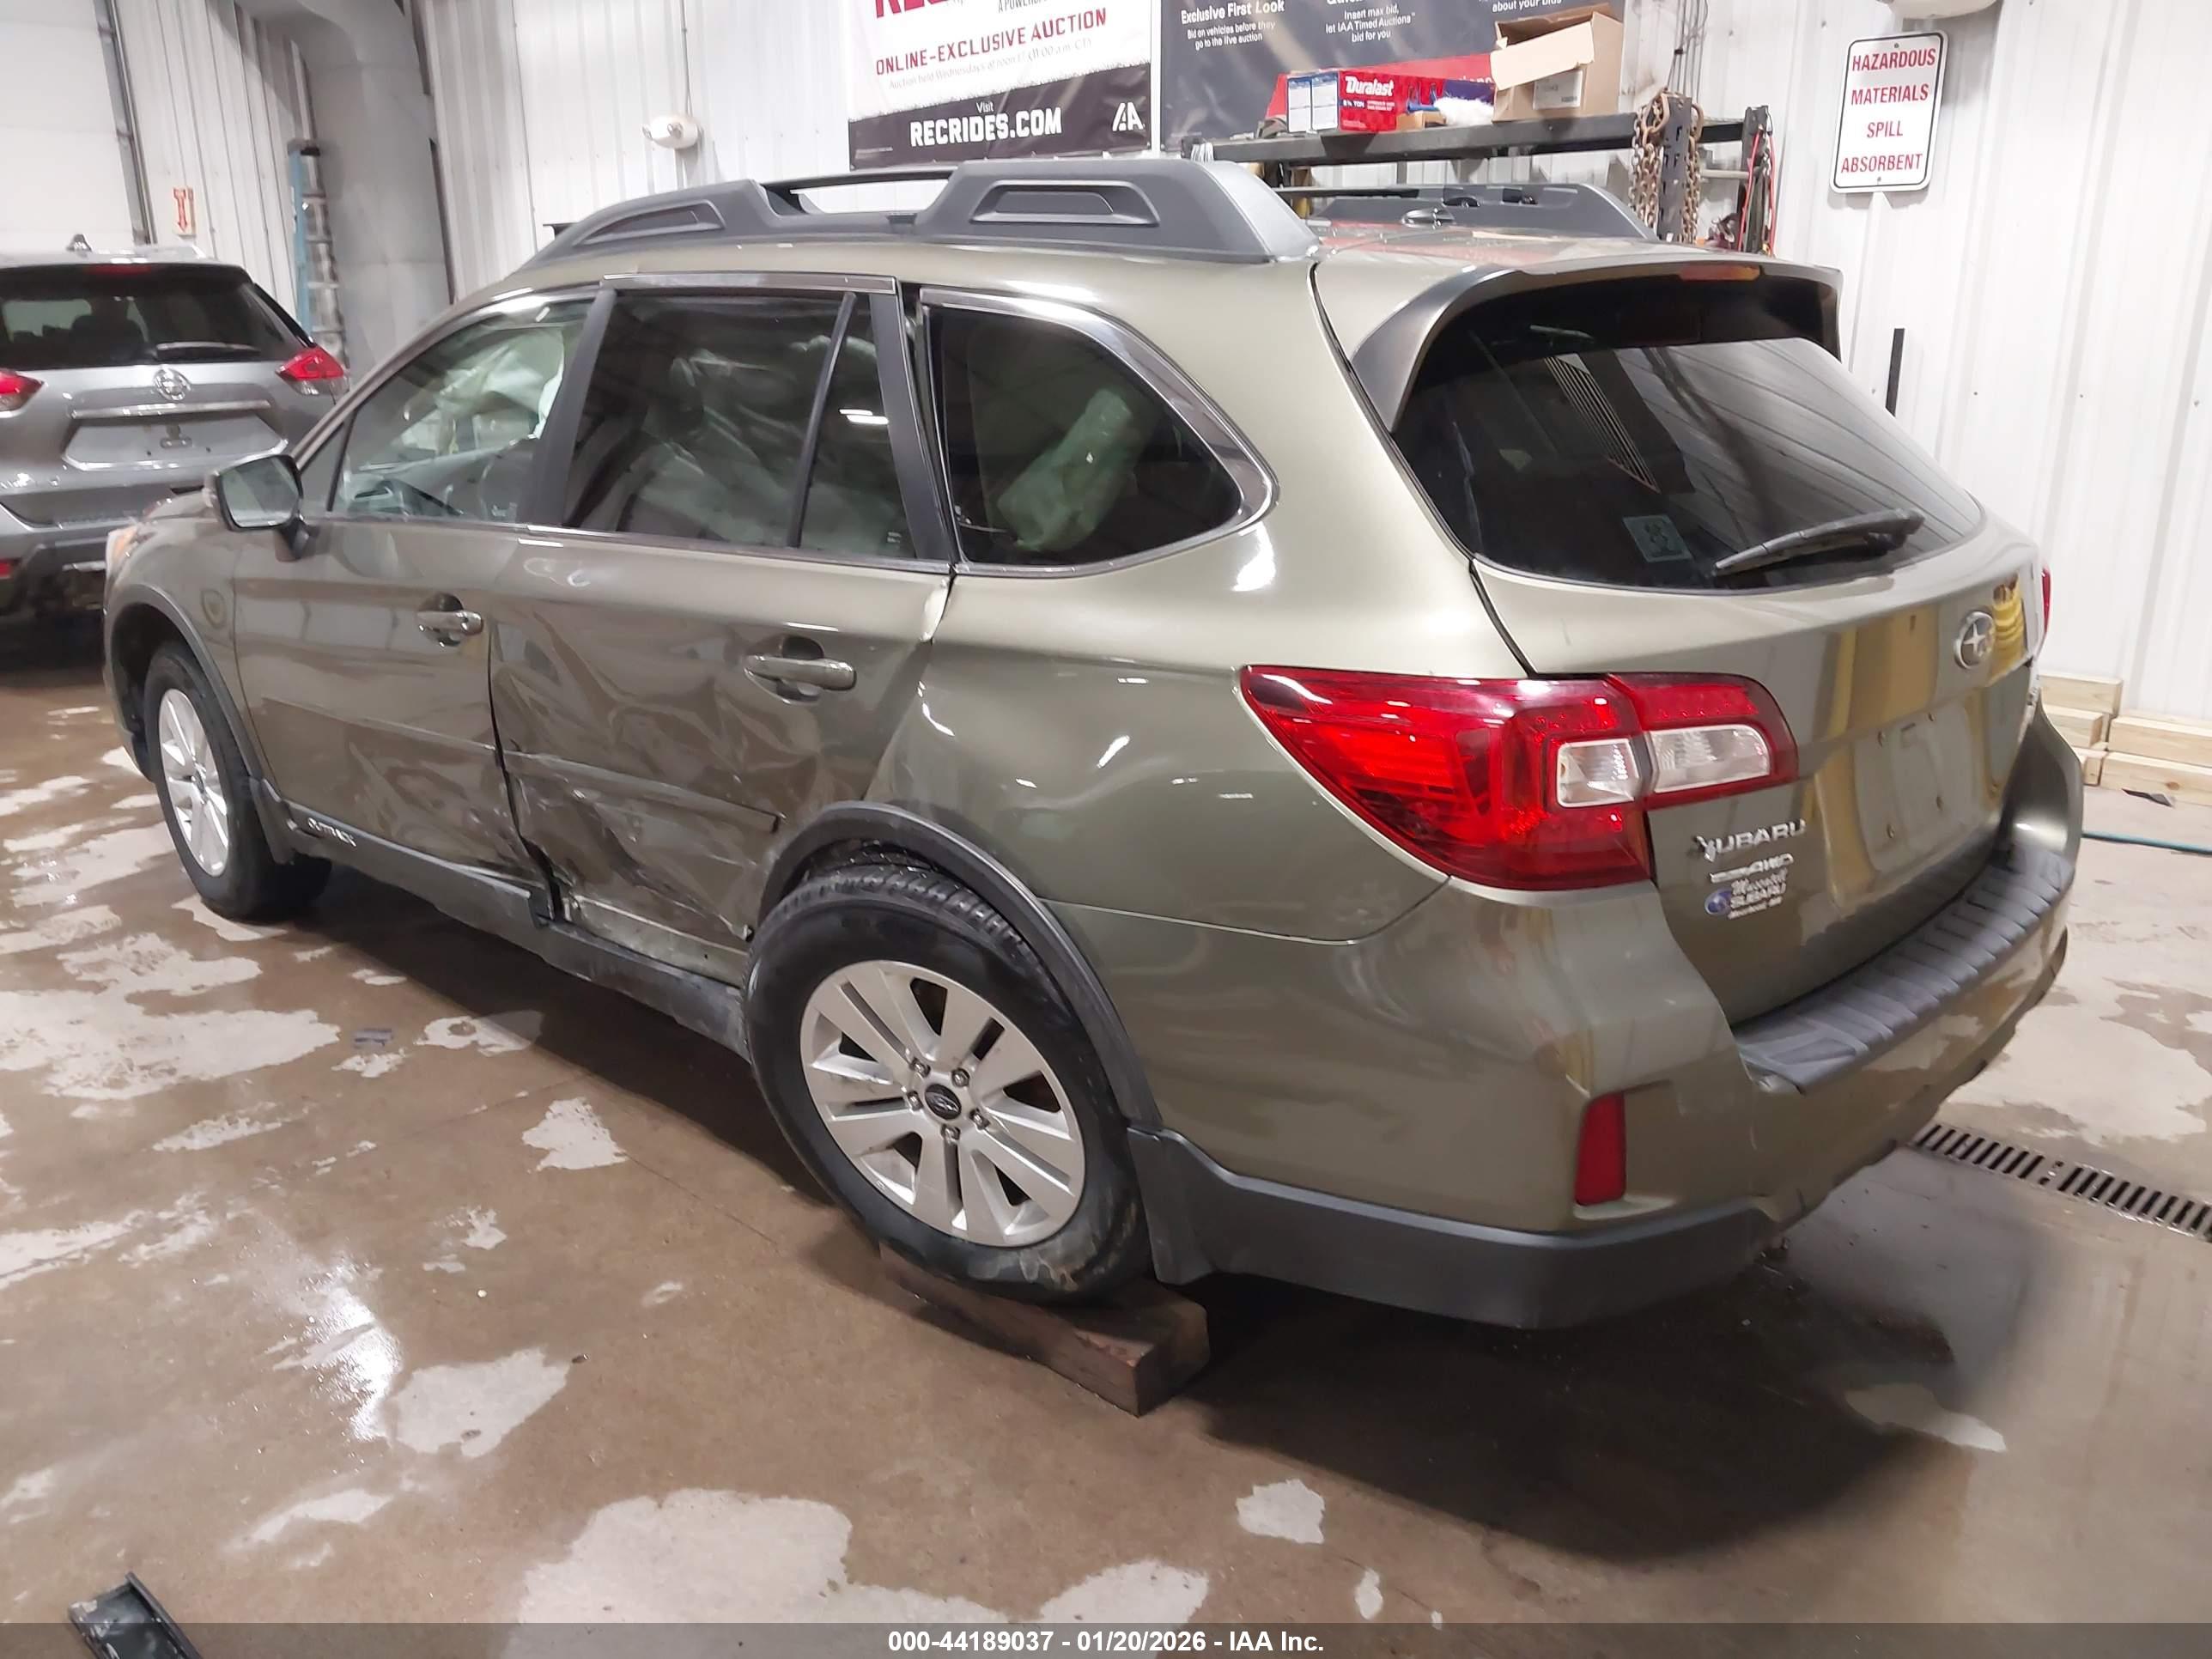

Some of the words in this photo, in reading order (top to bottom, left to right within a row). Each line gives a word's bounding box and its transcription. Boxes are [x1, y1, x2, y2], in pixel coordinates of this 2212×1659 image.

[1181, 5, 1226, 24] Exclusive
[1227, 2, 1252, 17] First
[1255, 0, 1285, 14] Look
[1344, 9, 1366, 21] Insert
[1367, 8, 1384, 18] max
[1385, 3, 1400, 15] bid,
[1492, 2, 1517, 13] about
[1519, 0, 1540, 10] your
[1187, 27, 1197, 40] Bid
[1197, 29, 1206, 38] on
[1206, 23, 1234, 36] vehicles
[1235, 21, 1256, 33] before
[1257, 20, 1276, 31] they
[1325, 23, 1336, 34] let
[1337, 21, 1354, 33] IAA
[1354, 17, 1377, 30] Timed
[876, 27, 1026, 76] ONLINE-EXCLUSIVE
[1030, 7, 1106, 41] AUCTION
[1194, 40, 1204, 51] go
[1204, 38, 1212, 47] to
[1212, 36, 1223, 46] the
[1224, 34, 1237, 45] live
[1237, 32, 1263, 44] auction
[1352, 31, 1364, 43] bid
[1365, 30, 1376, 40] for
[1376, 30, 1391, 40] you
[1851, 48, 1936, 71] HAZARDOUS
[1345, 75, 1395, 97] Duralast
[1850, 83, 1929, 106] MATERIALS
[975, 101, 994, 114] Visit
[909, 106, 1062, 147] RECRIDES.COM
[1866, 120, 1904, 138] SPILL
[1840, 153, 1923, 173] ABSORBENT
